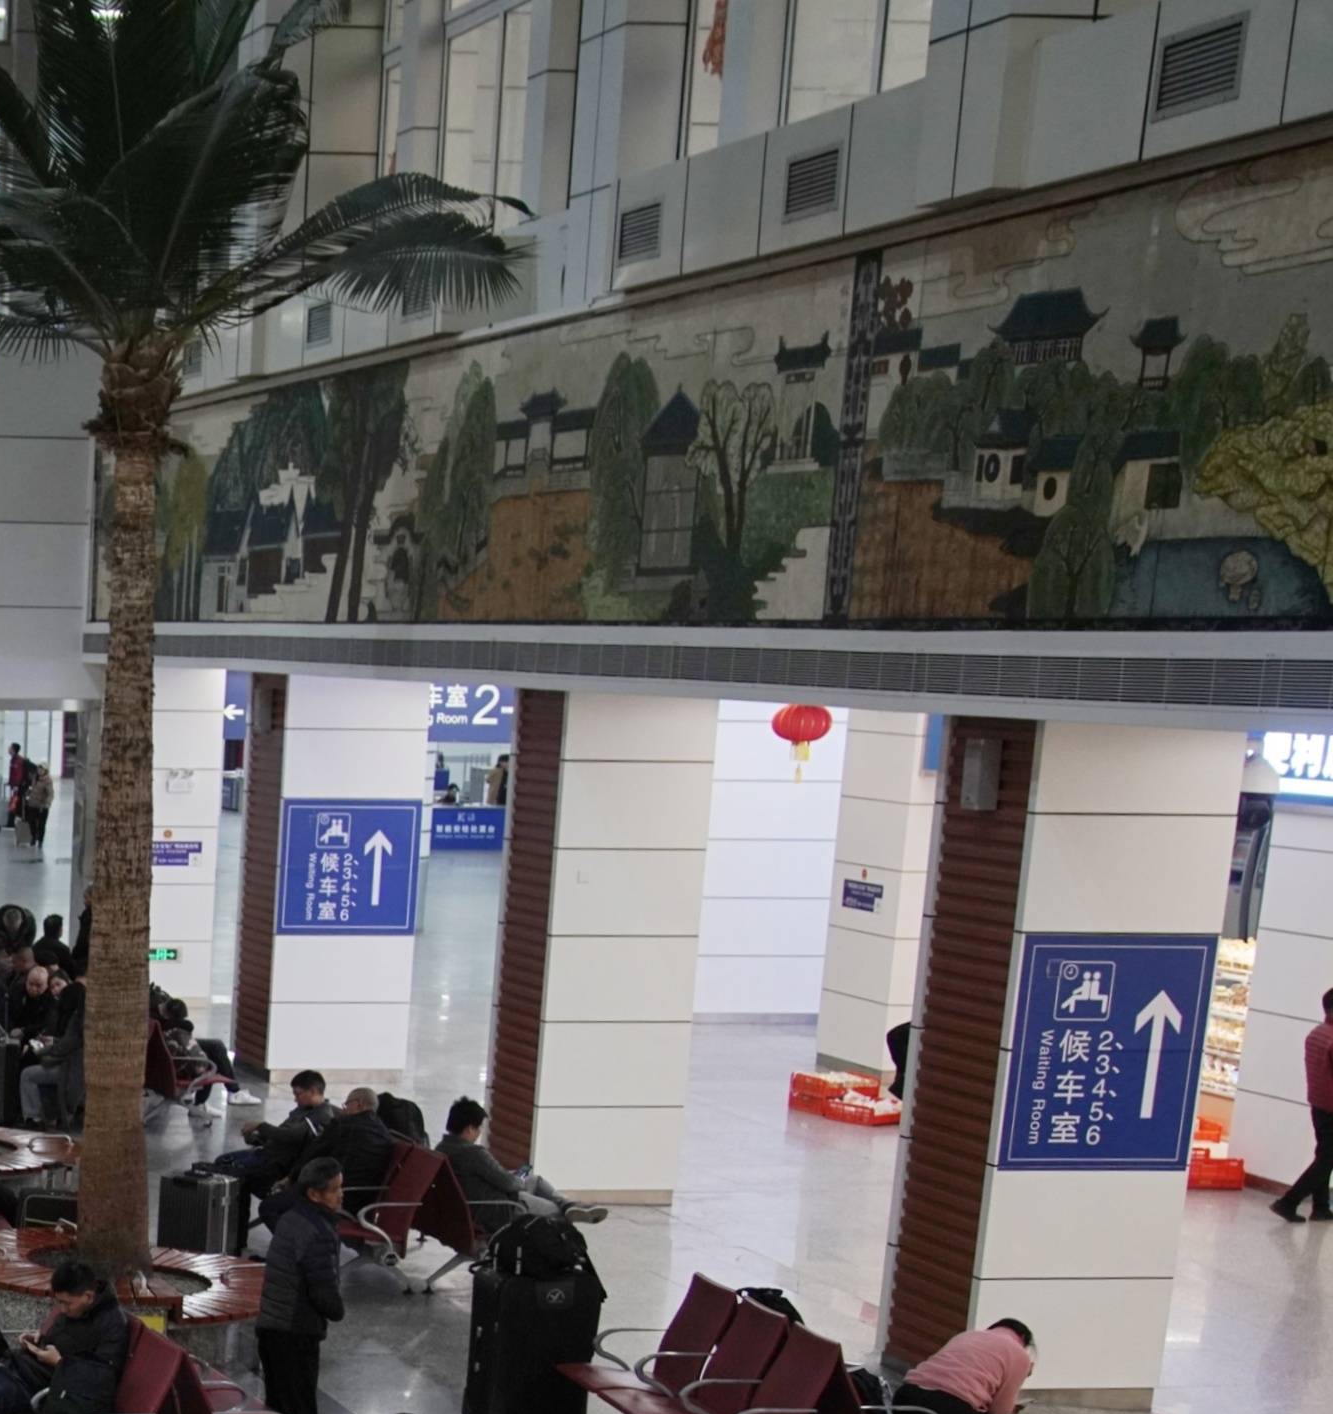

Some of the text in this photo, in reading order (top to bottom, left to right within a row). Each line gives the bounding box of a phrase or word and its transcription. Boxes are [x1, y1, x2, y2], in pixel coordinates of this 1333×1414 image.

[436, 712, 468, 725] Room
[305, 852, 317, 921] Waiting Room
[317, 852, 340, 921] 候车室
[1028, 1029, 1055, 1145] Waiting Room
[1047, 1029, 1092, 1144] 候车室
